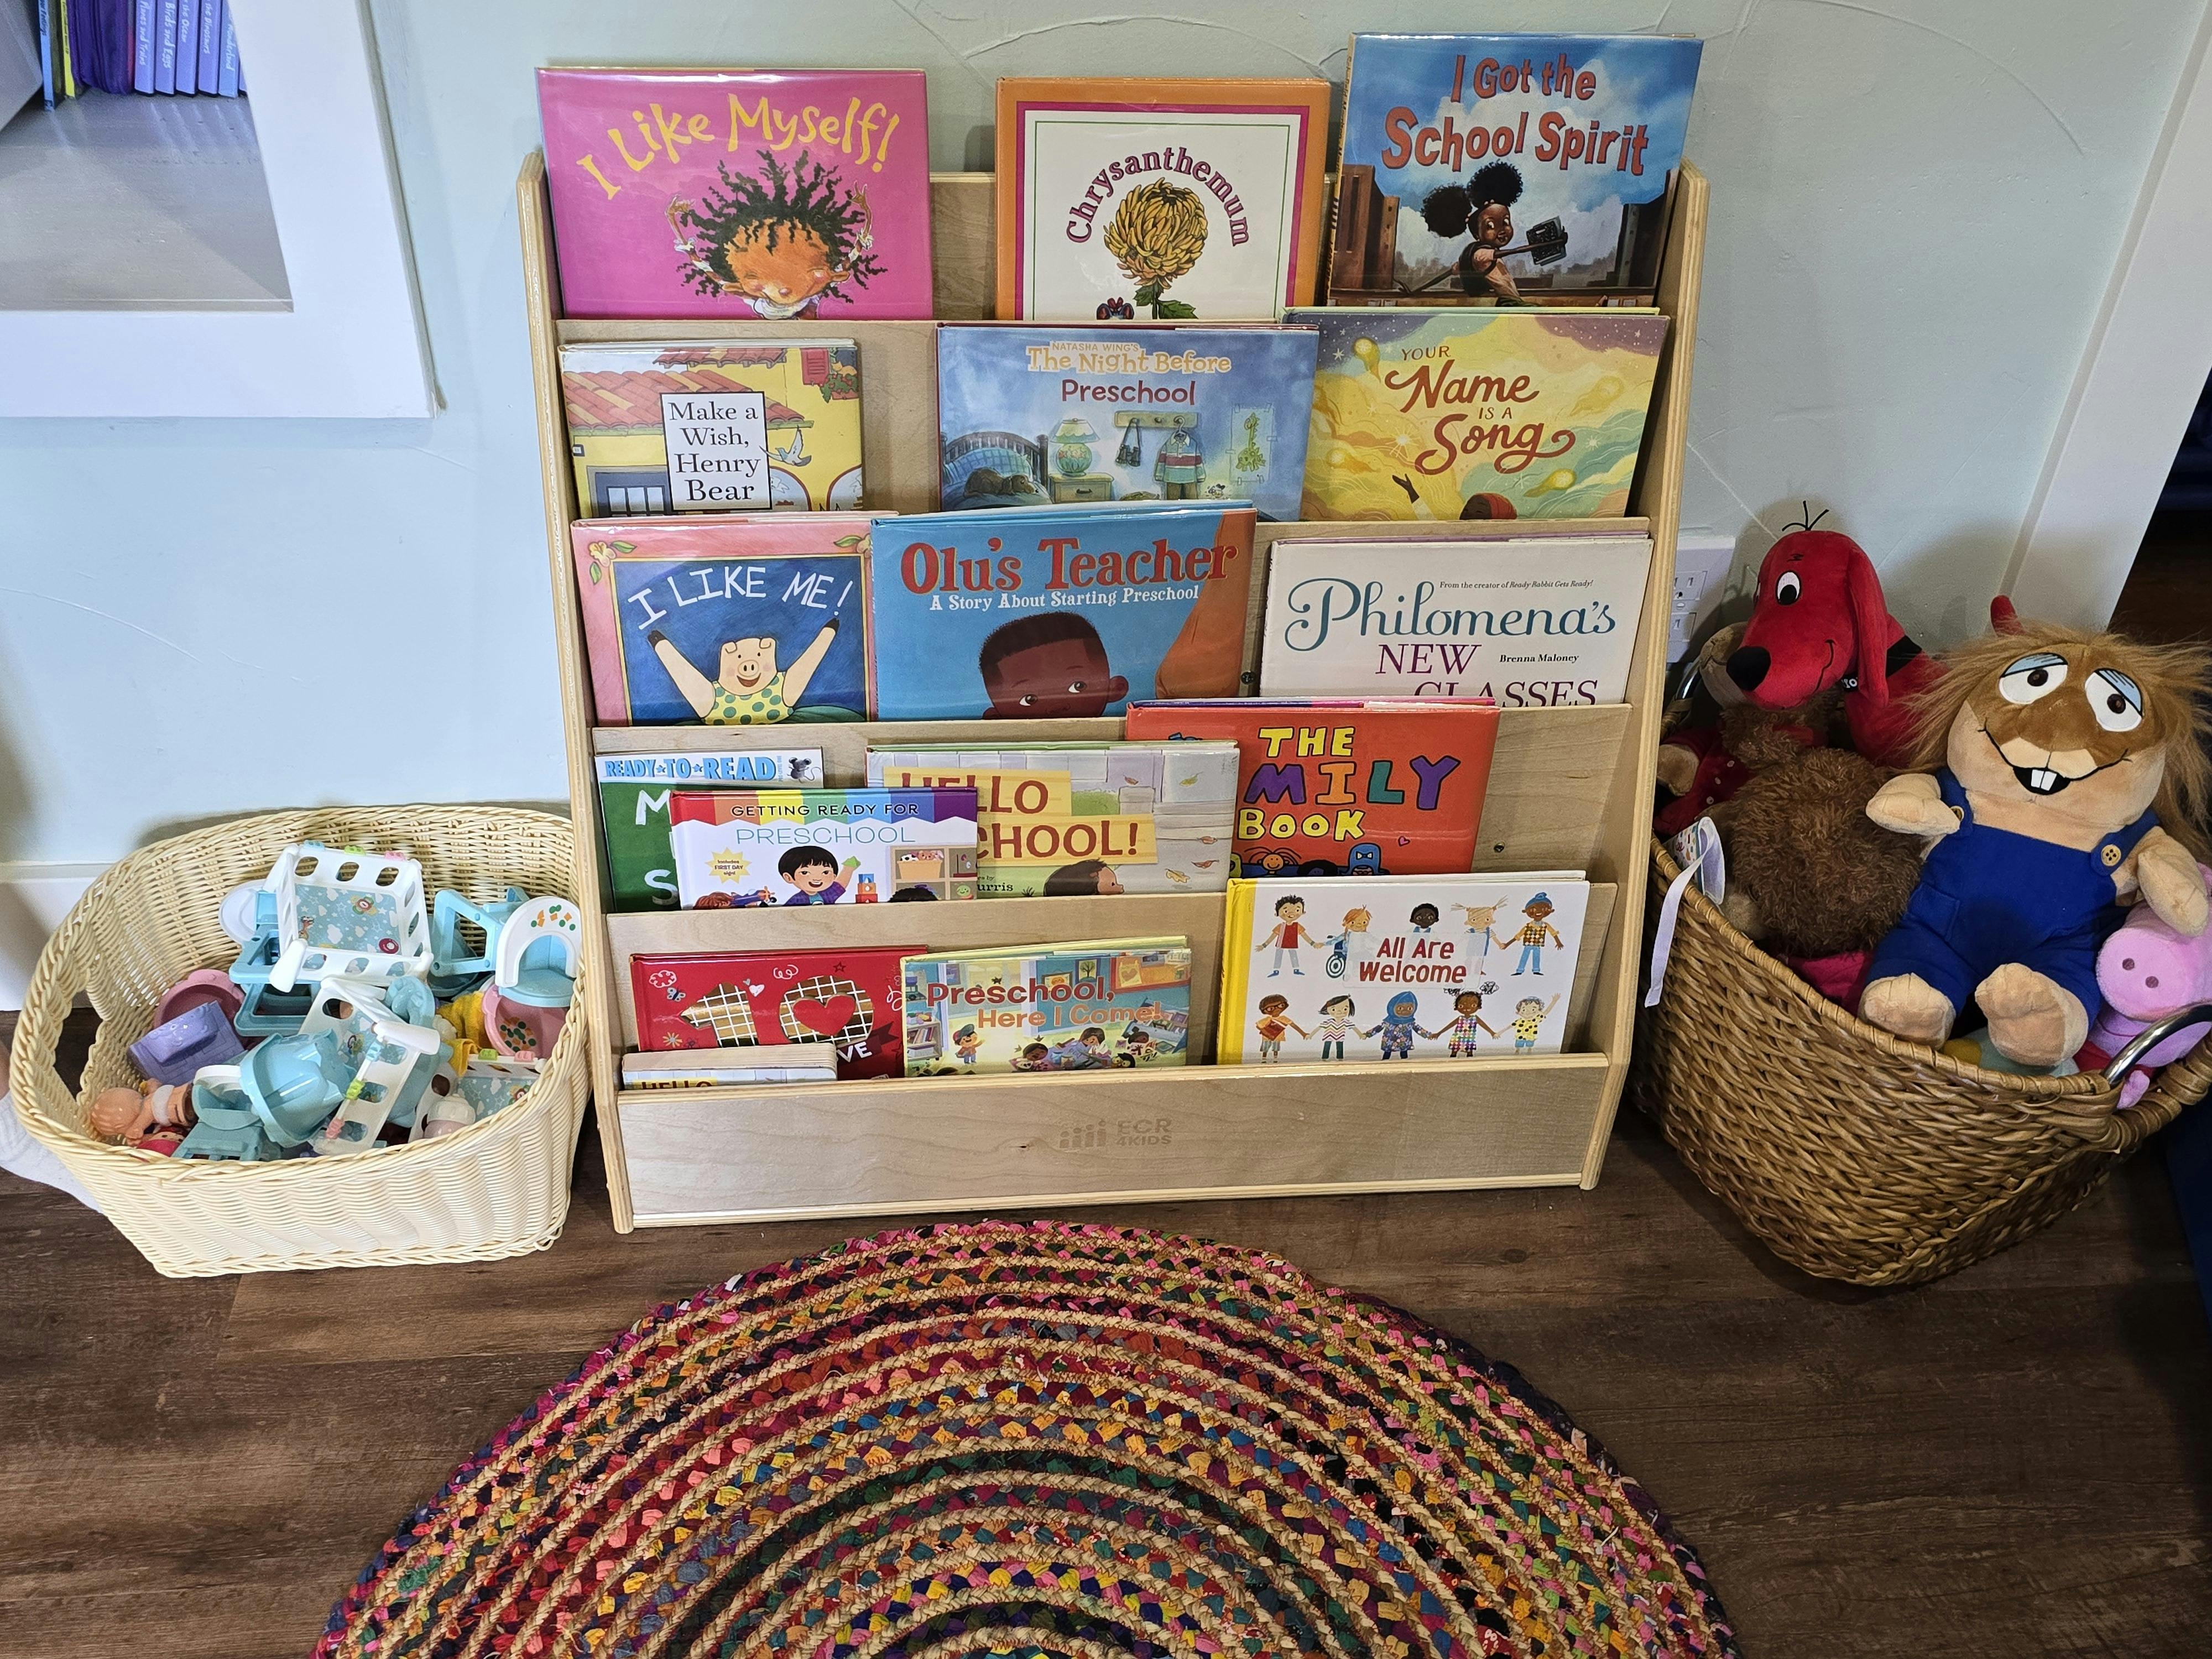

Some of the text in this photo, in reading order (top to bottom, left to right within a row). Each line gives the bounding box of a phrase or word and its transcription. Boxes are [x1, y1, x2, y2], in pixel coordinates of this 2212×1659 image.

[139, 27, 149, 42] and
[162, 2, 176, 69] Birds and Eggs
[203, 3, 212, 54] the Dinosaurs
[1451, 53, 1596, 103] I Got the
[576, 92, 900, 200] I Like Myself!
[1381, 106, 1528, 172] School
[1535, 112, 1648, 176] Spirit
[1066, 147, 1250, 246] Chrysanthemum
[1028, 347, 1232, 373] The Night Before
[1052, 342, 1139, 352] NATASHA WING'S
[1401, 345, 1451, 361] YOUR
[1062, 379, 1196, 405] Preschool
[1384, 359, 1540, 413] Name
[669, 401, 758, 421] Make a
[1479, 407, 1512, 420] IS A
[681, 427, 749, 447] Wish,
[1415, 413, 1576, 474] Song
[674, 453, 761, 477] Henry
[685, 479, 755, 502] Bear
[900, 538, 1022, 594] Olu's
[1038, 537, 1239, 591] Teacher
[628, 588, 667, 630] I
[667, 566, 766, 607] LIKE
[782, 571, 853, 616] ME!
[1510, 581, 1531, 590] Ready
[1570, 580, 1594, 588] Ready!
[930, 585, 1199, 612] A Story About Starting Preschool
[1284, 577, 1616, 651] Philomena's
[1375, 644, 1482, 675] NEW
[1499, 653, 1579, 665] Brenna Maloney
[1258, 727, 1355, 758] THE
[605, 757, 776, 781] READY TO READ
[902, 773, 1048, 814] LLO
[1244, 755, 1460, 811] MILY
[731, 802, 920, 817] GETTING READY FOR
[736, 826, 916, 846] PRESCHOOL
[1237, 807, 1366, 842] BOOK
[978, 821, 1139, 859] HOOL!
[977, 882, 1014, 891] urris
[1376, 937, 1454, 959] All Are
[1359, 960, 1467, 984] Welcome
[927, 976, 1115, 1008] Preschool,
[978, 1002, 1163, 1029] Here I Come!
[836, 1041, 873, 1063] VE
[1117, 1118, 1172, 1134] ECR
[1116, 1135, 1172, 1146] 4KIDS
